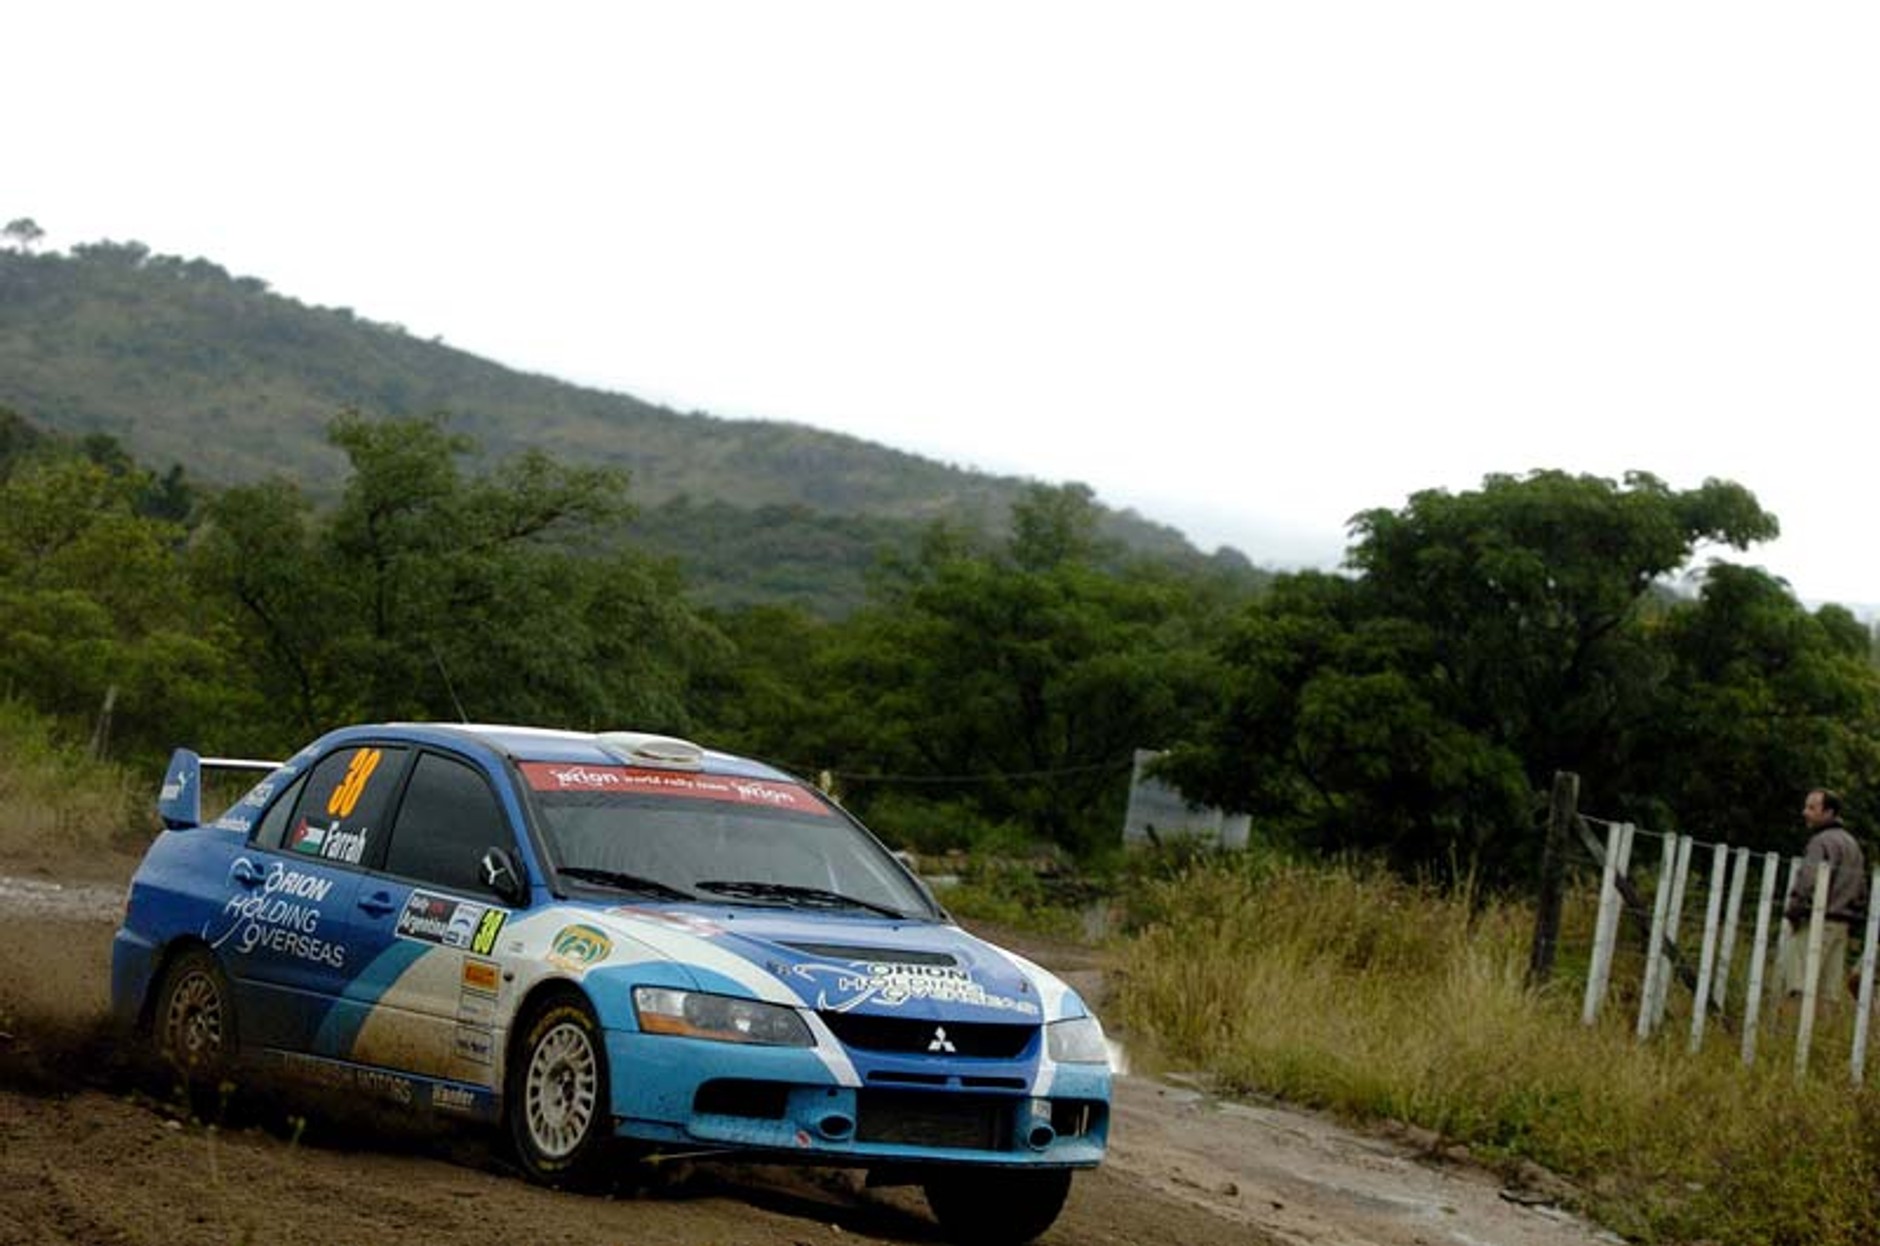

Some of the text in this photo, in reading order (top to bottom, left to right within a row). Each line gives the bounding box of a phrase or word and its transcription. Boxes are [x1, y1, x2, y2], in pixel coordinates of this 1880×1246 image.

[321, 820, 368, 864] Farrah
[265, 862, 333, 901] ORION
[223, 892, 320, 933] HOLDING
[236, 923, 345, 967] OVERSEAS
[867, 962, 973, 984] ORION
